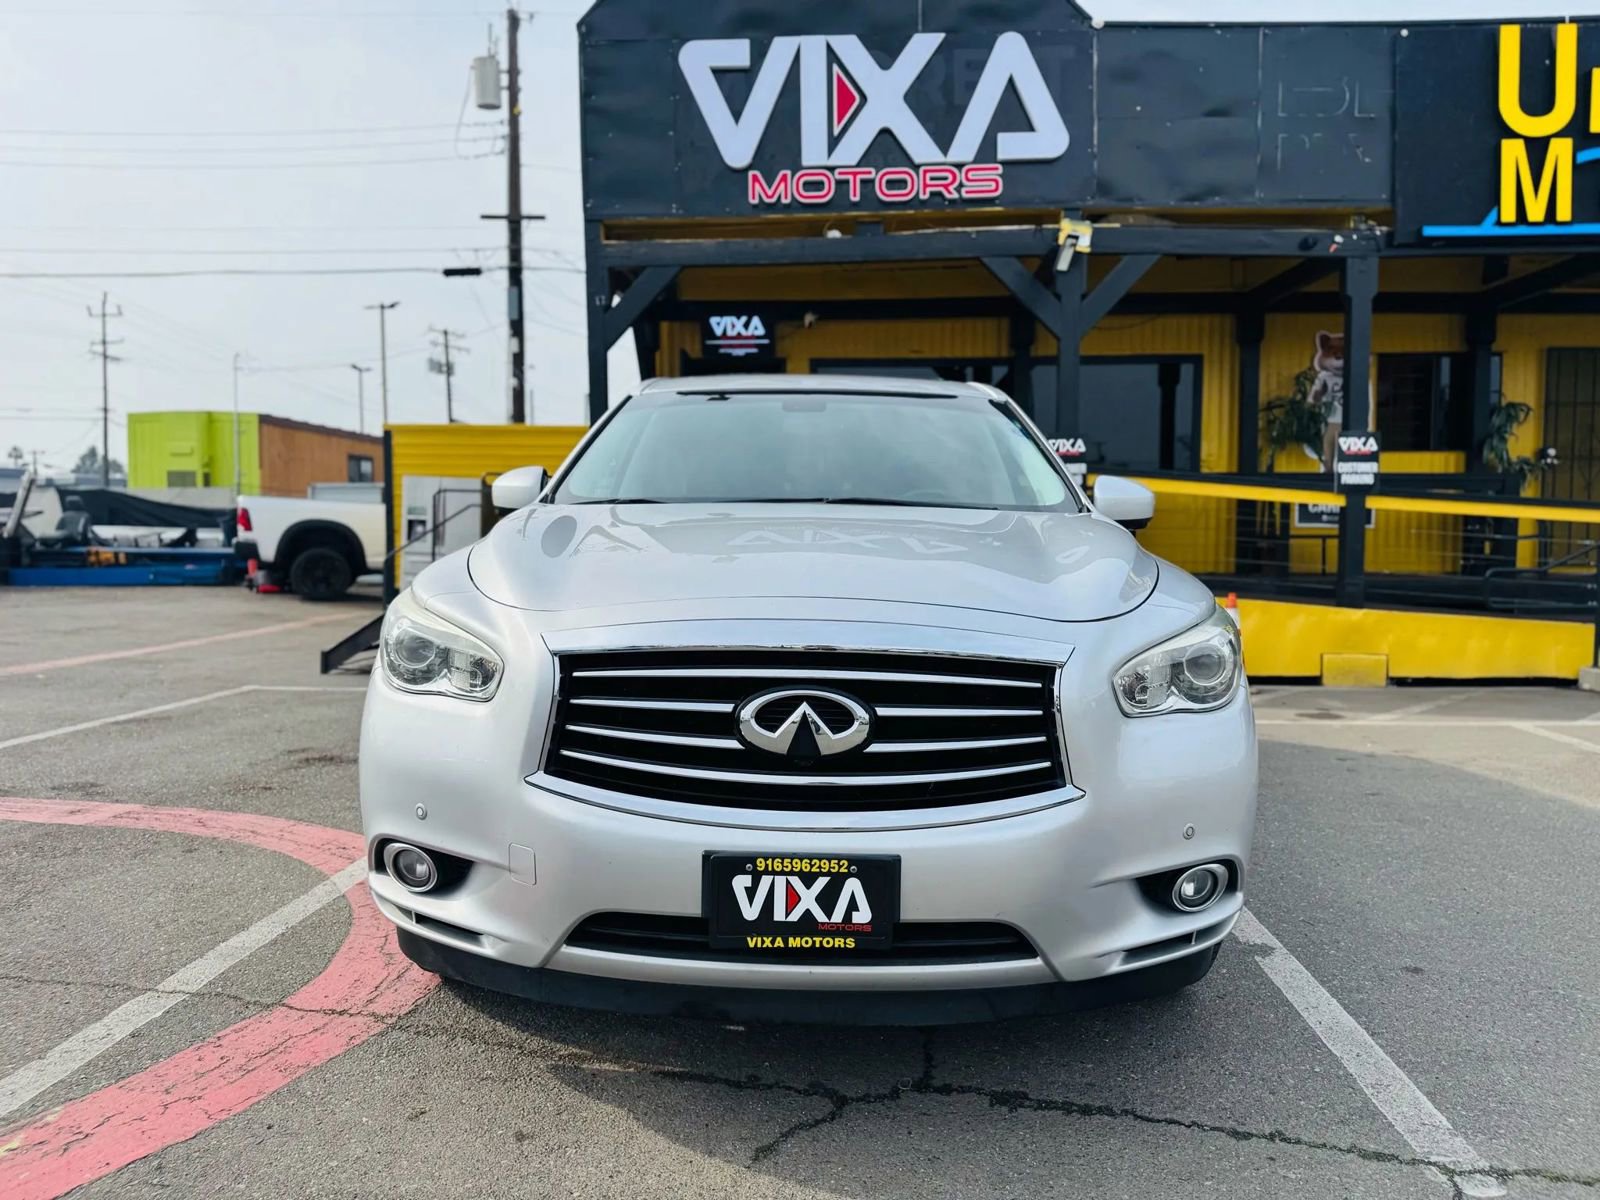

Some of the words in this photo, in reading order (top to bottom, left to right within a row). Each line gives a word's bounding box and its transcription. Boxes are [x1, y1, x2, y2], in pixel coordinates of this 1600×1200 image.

[678, 31, 1070, 170] VIXA
[747, 163, 1003, 204] MOTORS
[709, 315, 766, 336] VIXA
[1338, 436, 1378, 452] VIXA
[756, 858, 849, 873] 9165962952
[731, 874, 872, 924] VIXA
[817, 923, 872, 932] MOTORS
[747, 936, 784, 948] VIXA
[788, 936, 856, 949] MOTORS
